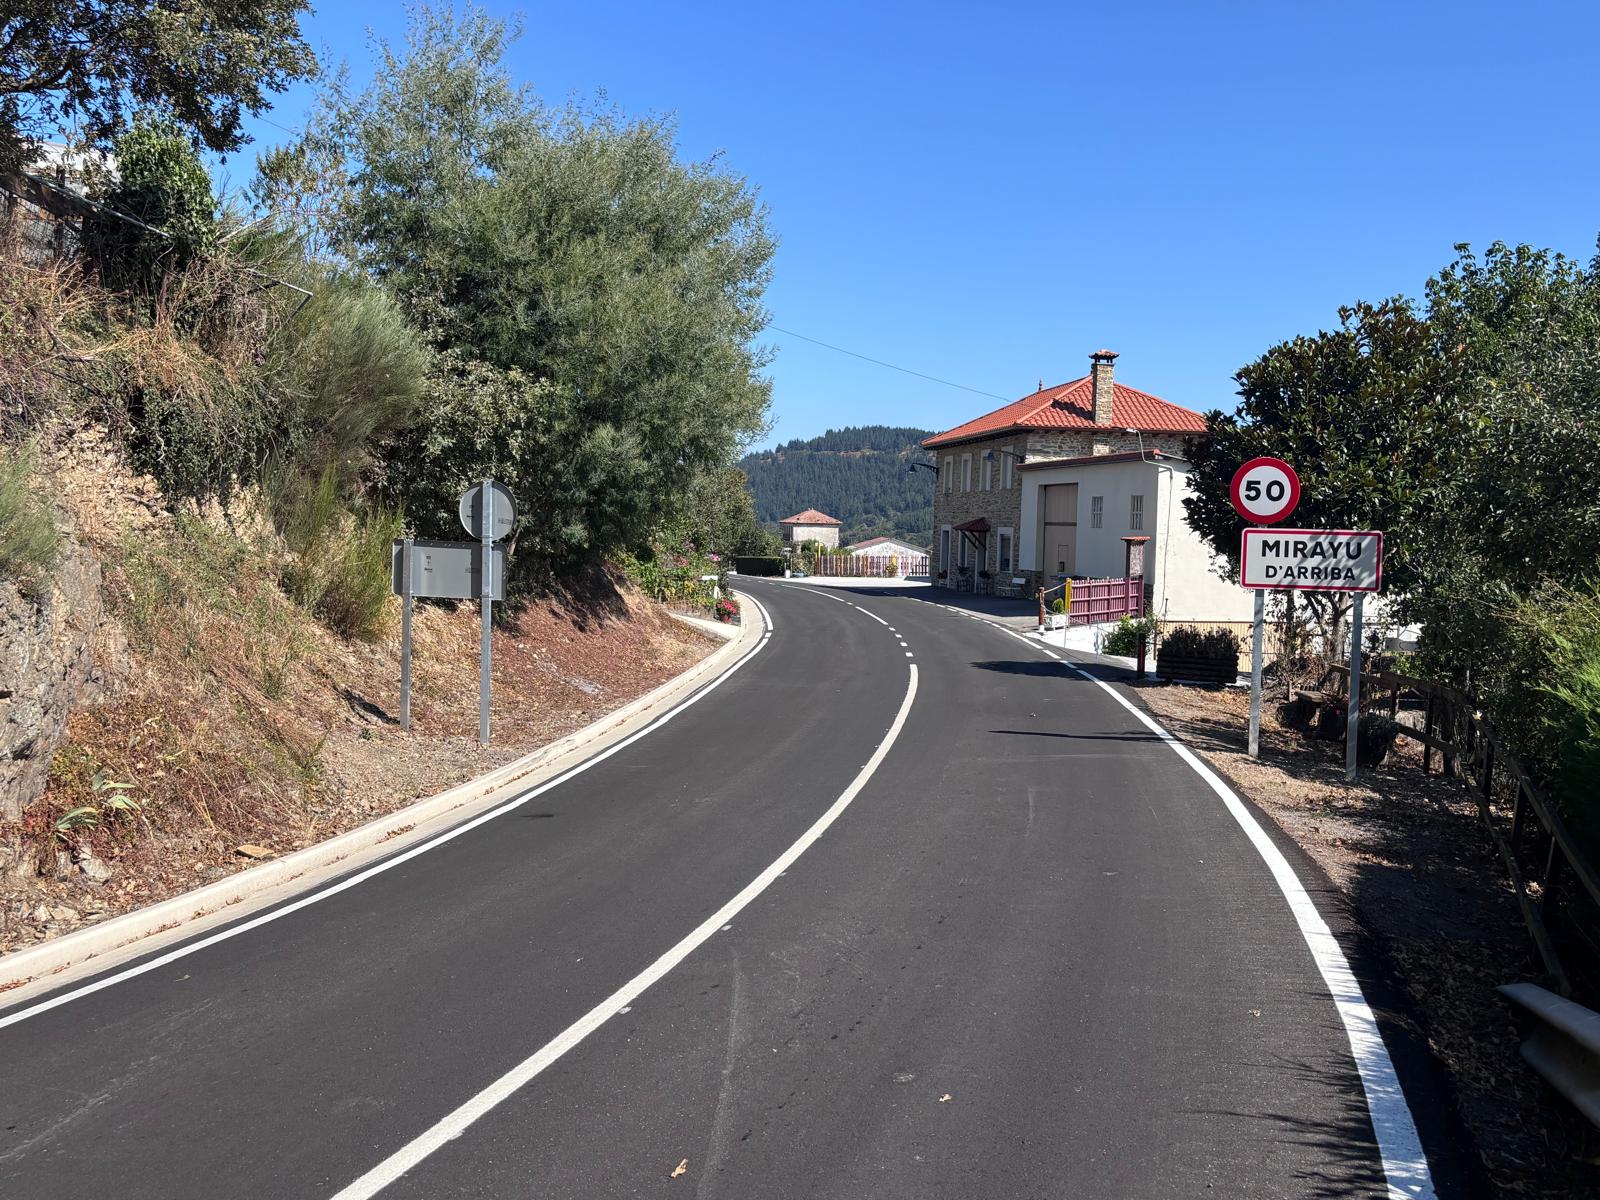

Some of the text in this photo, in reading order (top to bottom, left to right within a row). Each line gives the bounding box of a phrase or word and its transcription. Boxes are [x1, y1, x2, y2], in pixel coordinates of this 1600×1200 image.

[1244, 480, 1285, 502] 50
[1261, 539, 1362, 560] MIRAYU
[1265, 565, 1356, 581] D'ARRIBA
